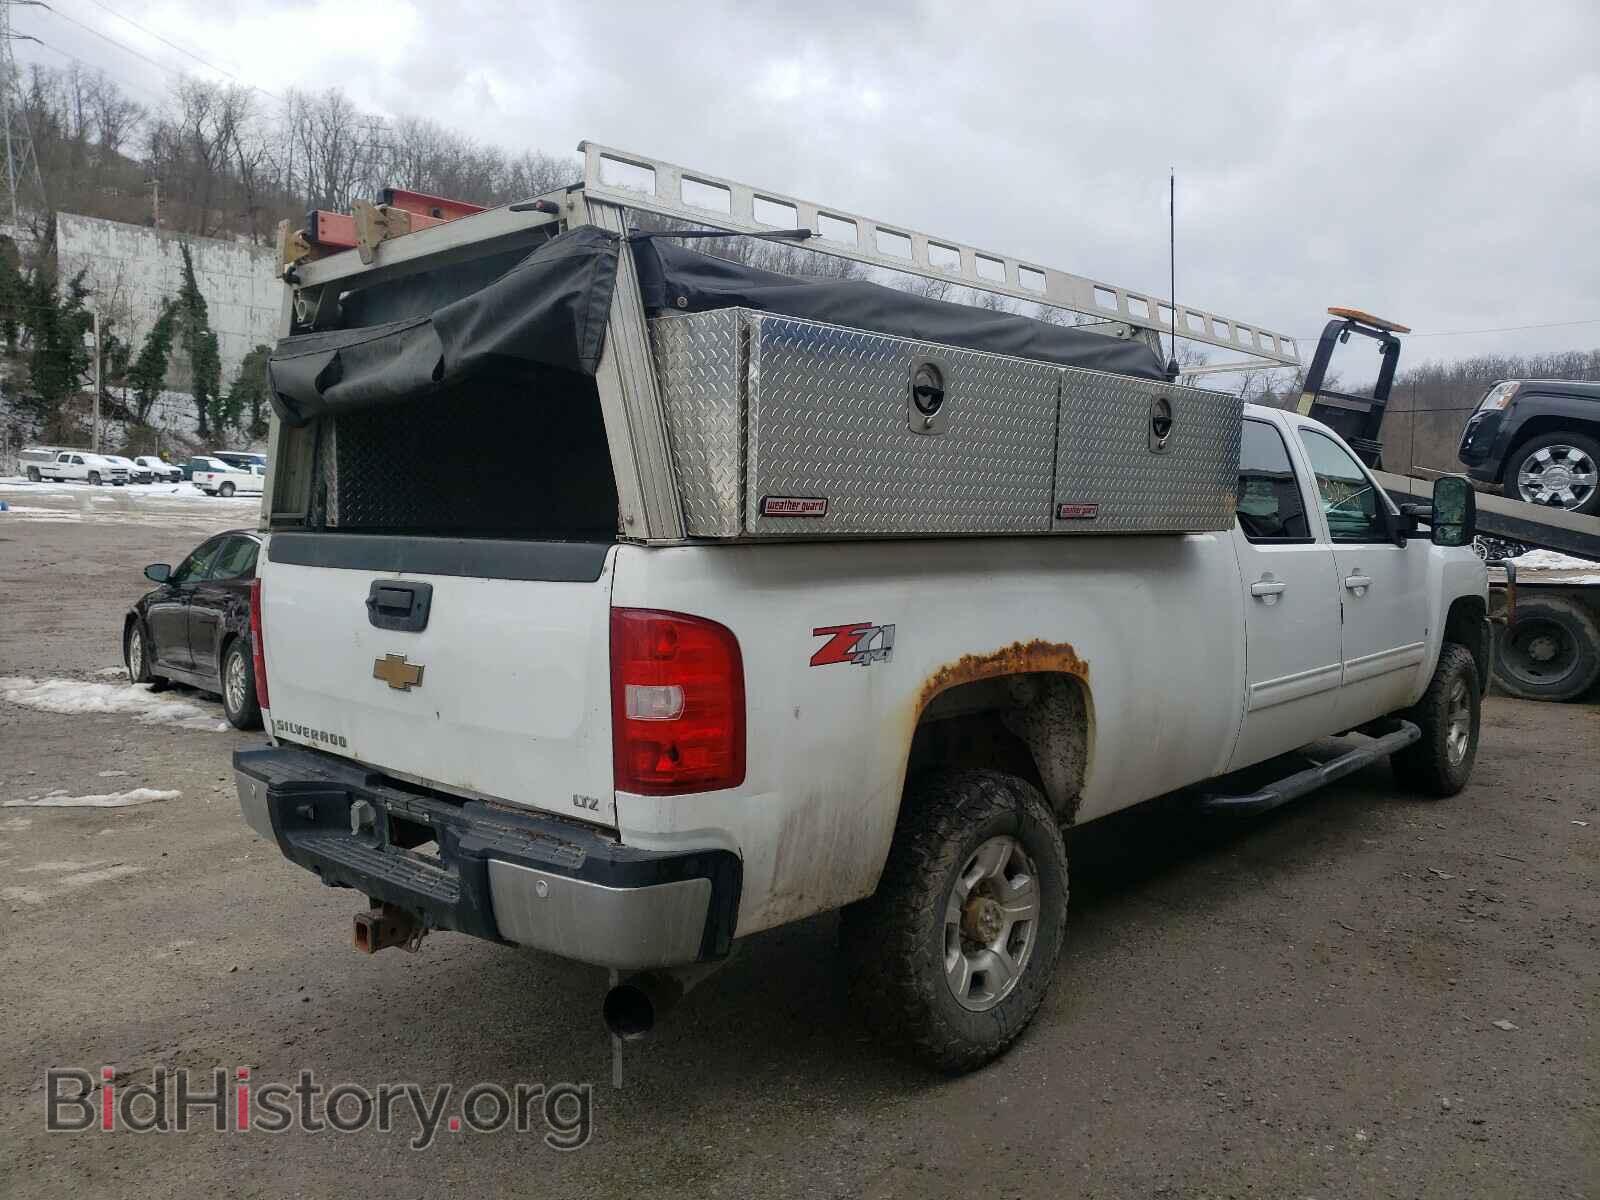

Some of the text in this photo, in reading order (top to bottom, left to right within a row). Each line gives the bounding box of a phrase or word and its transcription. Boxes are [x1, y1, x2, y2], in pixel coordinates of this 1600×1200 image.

[768, 499, 825, 513] weather guard
[809, 622, 896, 667] Z71
[276, 719, 347, 748] SILVERADO
[573, 789, 600, 811] LTZ
